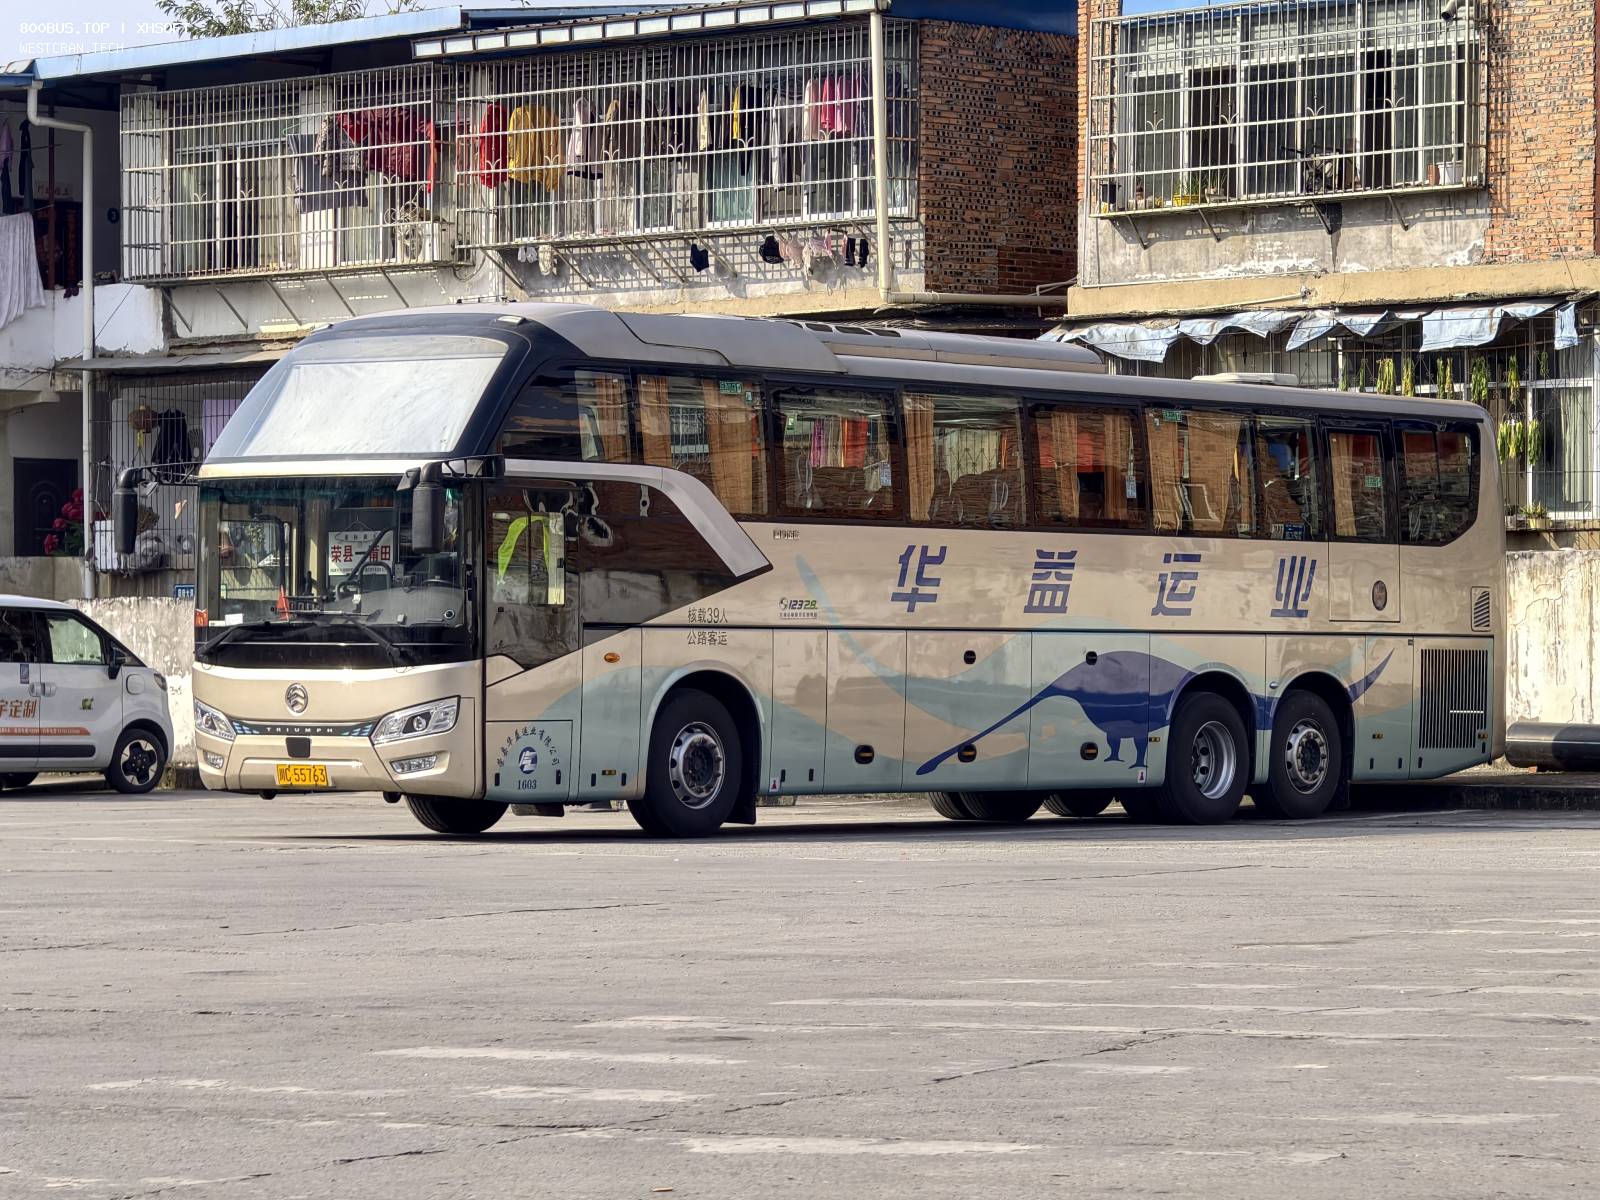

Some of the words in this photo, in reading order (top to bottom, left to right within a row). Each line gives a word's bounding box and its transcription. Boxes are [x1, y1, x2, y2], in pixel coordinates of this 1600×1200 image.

[890, 544, 1318, 618] 华益运业
[788, 599, 818, 610] 12328
[687, 607, 728, 624] 核载39人
[687, 630, 728, 646] 公路客运
[518, 779, 538, 790] 1603
